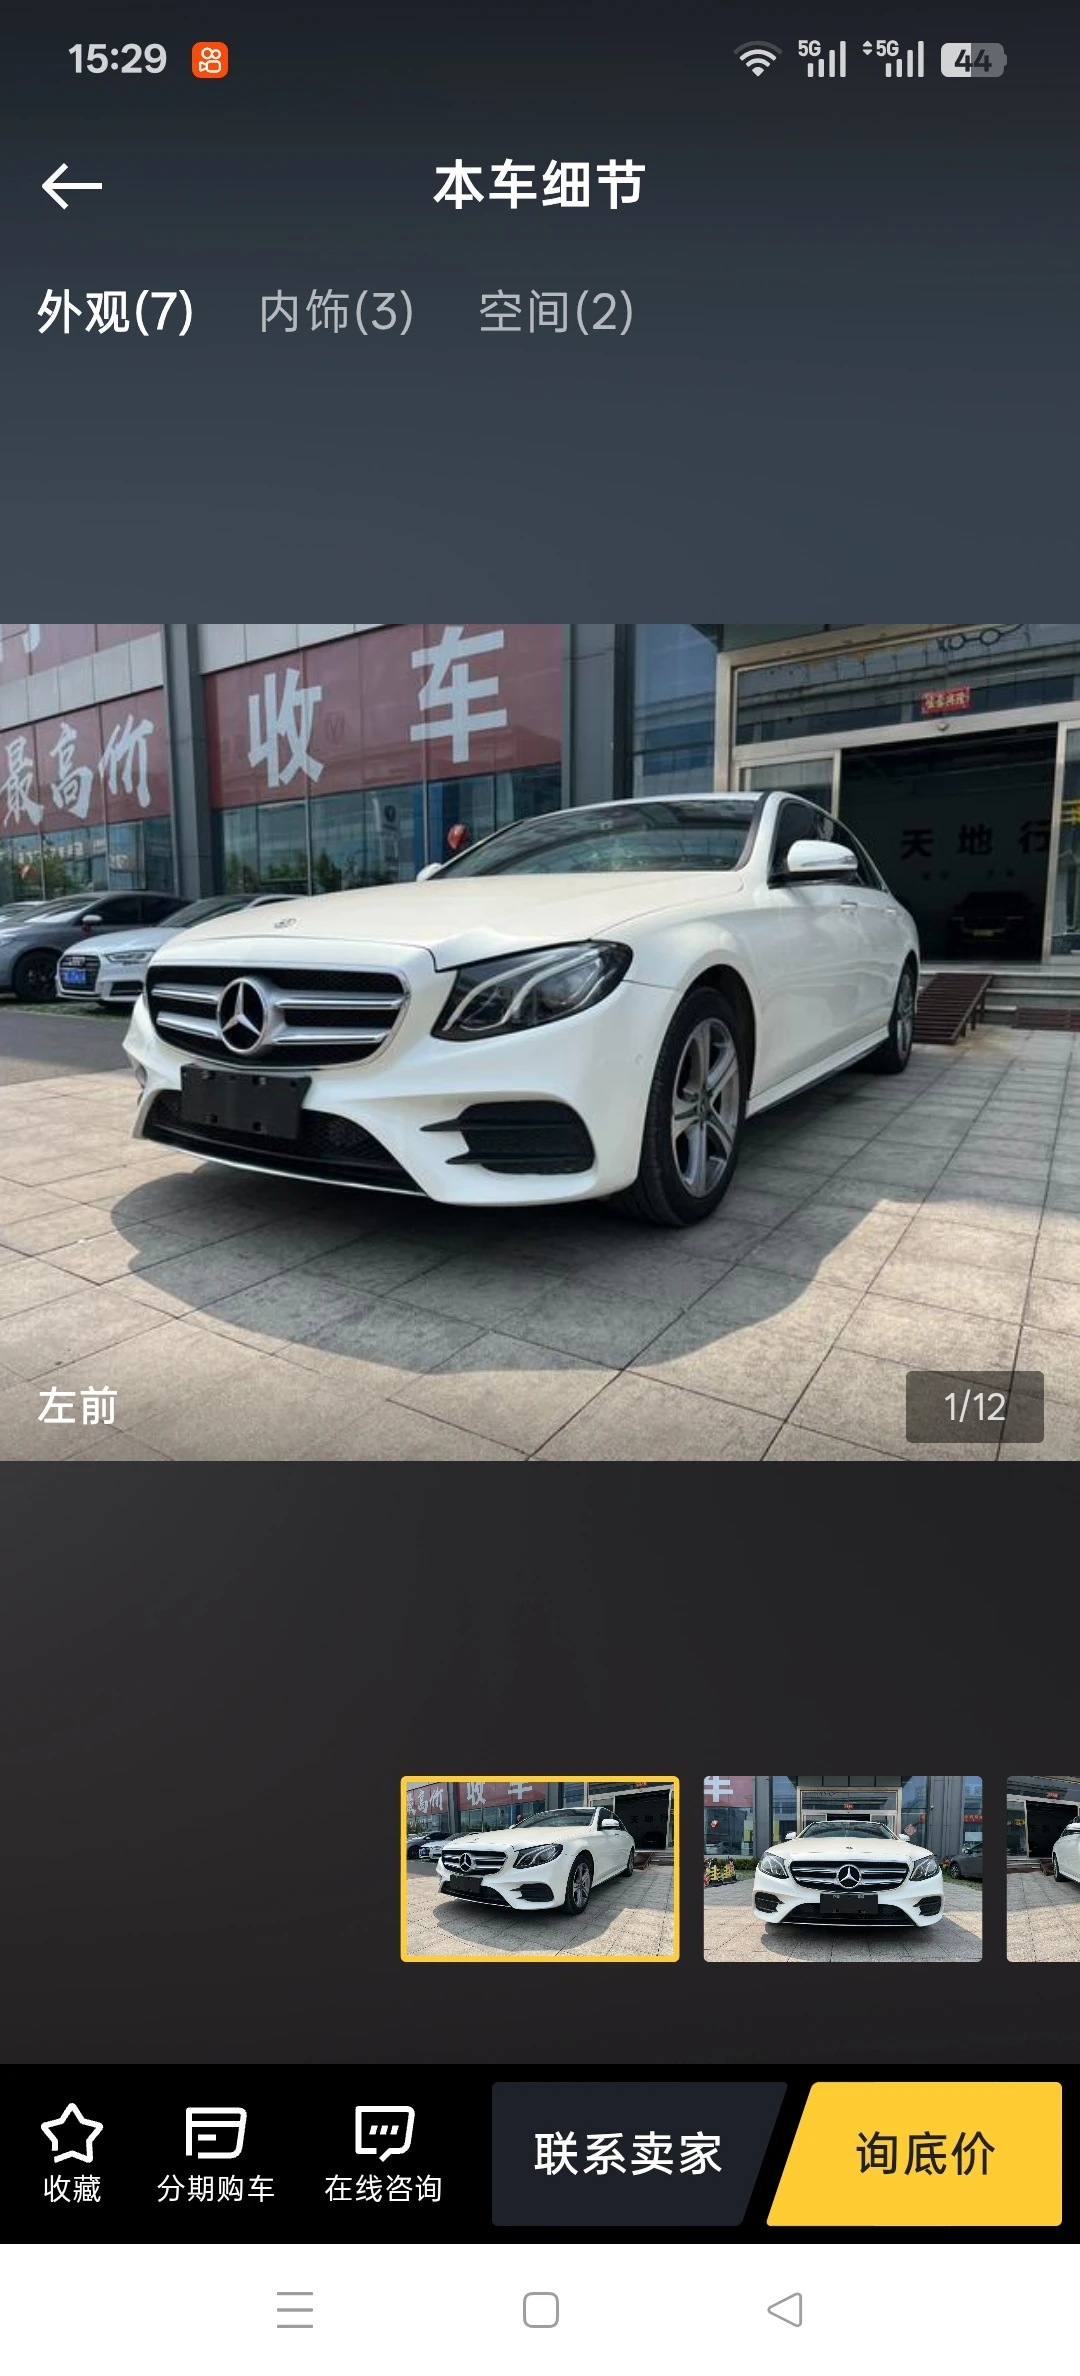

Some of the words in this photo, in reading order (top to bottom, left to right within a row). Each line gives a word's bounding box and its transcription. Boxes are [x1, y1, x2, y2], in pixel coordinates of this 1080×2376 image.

[68, 43, 167, 74] 15:29
[798, 39, 821, 57] 5G
[876, 39, 899, 57] 5G
[954, 48, 992, 72] 44
[433, 158, 645, 210] 本车细节
[36, 288, 193, 337] 外观(7)
[260, 288, 413, 337] 内饰(3)
[479, 288, 633, 337] 空间(2)
[0, 714, 154, 827] 最高价
[901, 819, 1050, 860] 天地行
[533, 2130, 723, 2176] 联系卖家
[856, 2130, 996, 2176] 询底价
[43, 2173, 102, 2204] 收藏
[157, 2173, 275, 2203] 分期购车
[324, 2173, 442, 2203] 在线咨询
